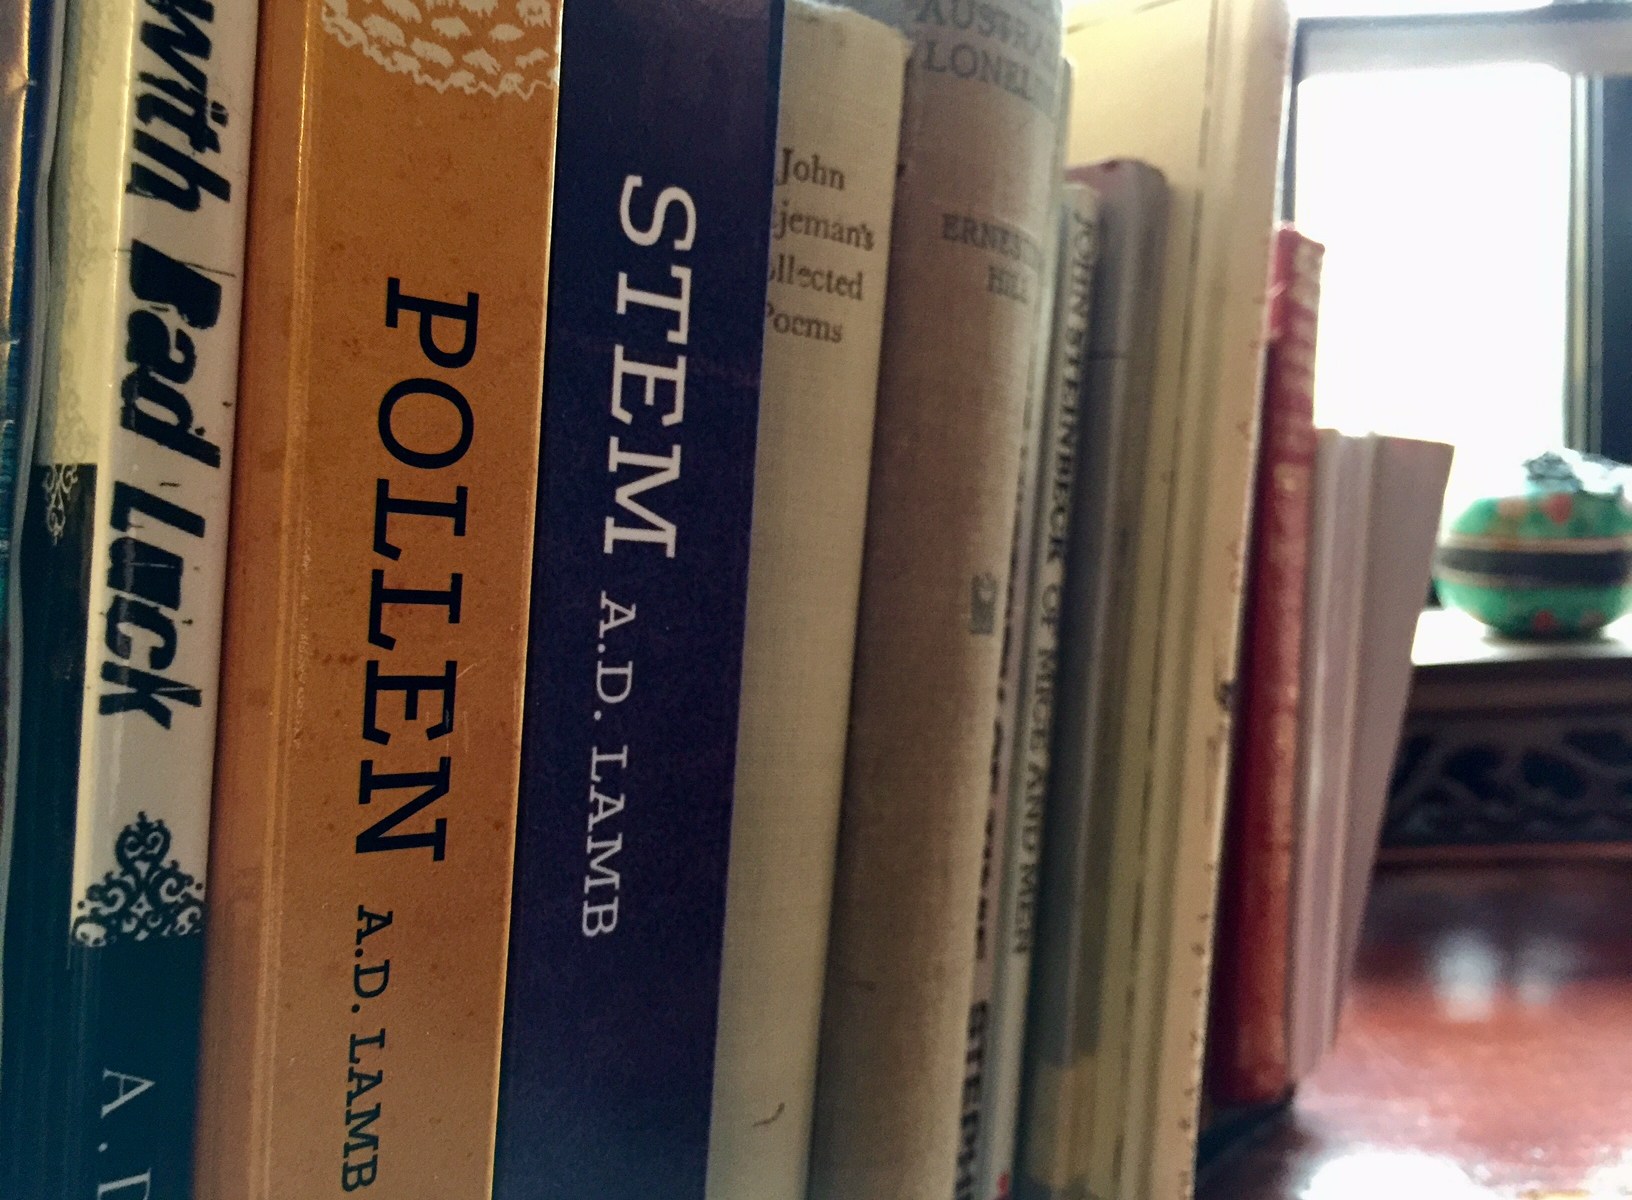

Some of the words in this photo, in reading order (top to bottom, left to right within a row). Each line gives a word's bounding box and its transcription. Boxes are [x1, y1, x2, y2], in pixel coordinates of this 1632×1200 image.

[772, 199, 874, 251] jeman's
[776, 147, 846, 191] John
[1067, 210, 1096, 319] JOHN
[120, 238, 222, 469] Bad
[604, 174, 697, 558] STEM
[1045, 325, 1083, 565] STEINBECK
[98, 480, 206, 730] Luck
[355, 276, 480, 862] POLLEN
[1040, 582, 1062, 628] OF
[596, 590, 636, 721] A.D.
[1028, 647, 1058, 752] MICE
[581, 744, 629, 937] LAMB
[1019, 760, 1048, 854] AND
[350, 904, 394, 1014] A.D.
[1013, 861, 1038, 955] MEN
[341, 1027, 386, 1193] LAMB
